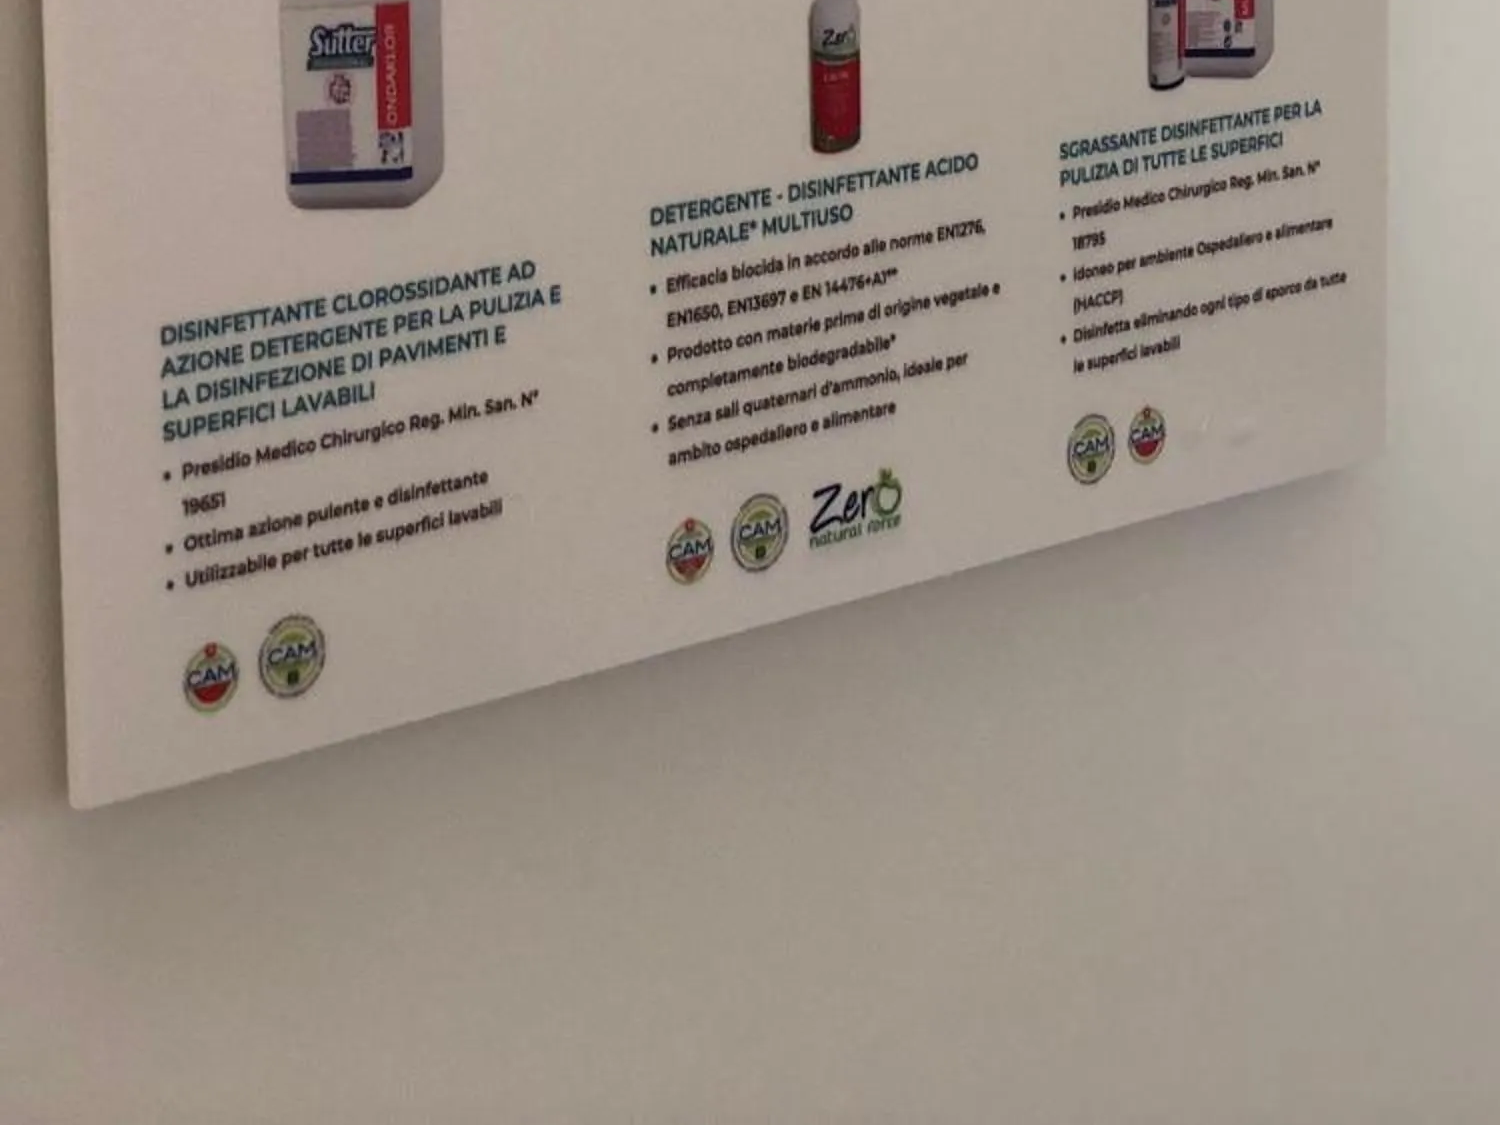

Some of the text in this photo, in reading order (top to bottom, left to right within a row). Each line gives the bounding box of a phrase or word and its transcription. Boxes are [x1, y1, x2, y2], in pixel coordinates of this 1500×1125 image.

[310, 25, 376, 57] Sutter
[1059, 99, 1322, 160] SGRASSANTE DISINFETTANTE PER LA
[1059, 131, 1284, 187] PULIZIA DI TUTTE LE SUPERFICI
[649, 187, 774, 227] DETERGENTE
[787, 162, 922, 203] DISINFETTANTE
[924, 152, 979, 179] ACIDO
[761, 203, 853, 237] MULTIUSO
[1072, 198, 1121, 219] Presidio
[1122, 191, 1166, 210] Medico
[1167, 179, 1228, 202] Chirurgico
[1229, 175, 1254, 191] Reg.
[1256, 169, 1280, 184] Min.
[1281, 165, 1305, 180] San.
[665, 267, 729, 294] Efficacia
[731, 257, 784, 281] biocida
[787, 254, 801, 271] in
[803, 243, 860, 267] accordo
[862, 238, 887, 256] alle
[889, 231, 934, 251] norme
[1116, 258, 1137, 275] per
[1139, 246, 1195, 268] ambiente
[1196, 232, 1264, 256] Ospedaliero
[1265, 230, 1273, 242] e
[1275, 218, 1333, 240] alimentare
[160, 260, 536, 346] DISINFETTANTE CLOROSSIDANTE AD
[667, 283, 1001, 363] Prodotto con materie prime di origine vegetale e
[789, 290, 799, 304] e
[801, 283, 822, 301] EN
[1073, 272, 1346, 343] Disinfetta eliminando ogni tipo di sporco da tutte
[160, 284, 562, 379] AZIONE DETERGENTE PER LA PULIZIA E
[1073, 335, 1181, 373] le superfici lavabili
[161, 325, 507, 411] LA DISINFEZIONE DI PAVIMENTI E
[667, 361, 784, 397] completamente
[667, 410, 713, 432] Senza
[715, 399, 740, 422] sali
[742, 383, 818, 417] quaternari
[903, 357, 944, 378] ideale
[945, 353, 968, 372] per
[161, 381, 376, 442] SUPERFICI LAVABILI
[181, 451, 252, 480] Presidio
[254, 439, 317, 465] Medico
[319, 420, 407, 450] Chirurgico
[408, 413, 445, 432] Reg.
[447, 403, 481, 424] Min.
[483, 398, 517, 416] San.
[668, 402, 896, 466] ambito ospedaliero e alimentare
[1130, 423, 1166, 443] CAM
[1072, 435, 1110, 457] CAM
[183, 471, 489, 552] Ottima azione pulente e disinfettante
[740, 517, 782, 541] CAM
[808, 471, 902, 533] Zero
[185, 498, 503, 588] Utilizzabile per tutte le superfici lavabili
[668, 537, 712, 561] CAM
[186, 663, 238, 689] CAM
[266, 641, 318, 665] CAM
